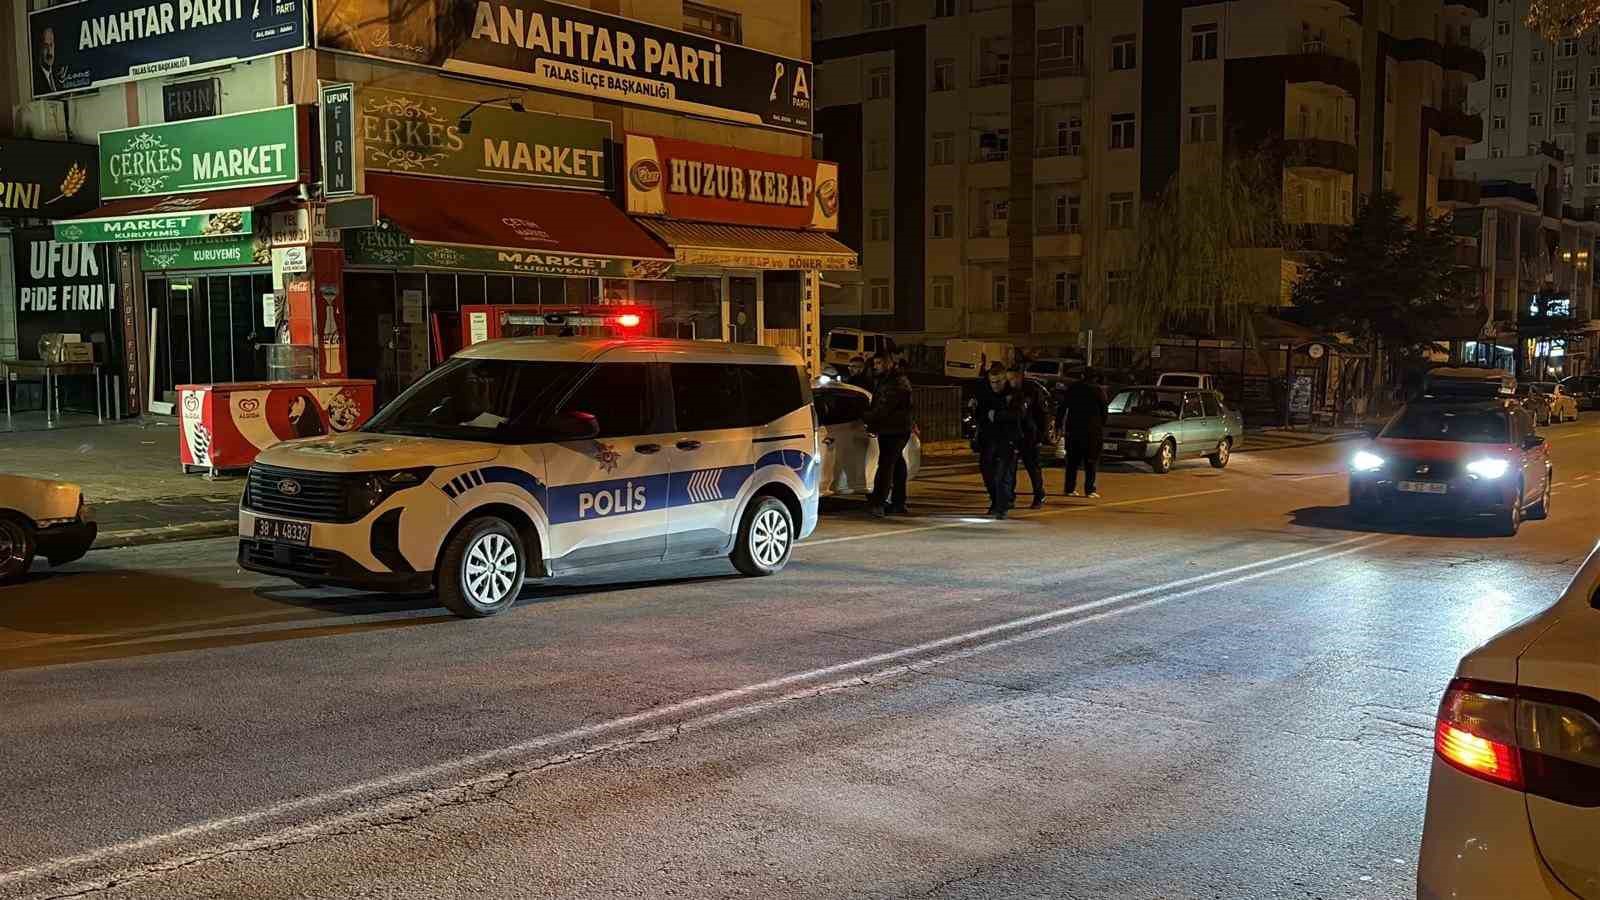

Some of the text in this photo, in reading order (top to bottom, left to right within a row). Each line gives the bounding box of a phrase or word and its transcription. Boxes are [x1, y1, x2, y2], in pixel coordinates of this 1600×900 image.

[79, 3, 174, 50] ANAHTAR
[472, 1, 722, 88] ANAHTAR PARTİ
[326, 92, 349, 104] UFUK
[543, 64, 670, 99] TALAS İLÇE BAŞKANLIĞI
[793, 67, 809, 98] A
[110, 143, 286, 184] ÇERKES MARKET
[334, 105, 344, 188] FIRIN
[363, 115, 463, 151] ERKES
[484, 138, 604, 177] MARKET
[671, 158, 814, 207] HUZUR KEBAP
[104, 216, 192, 233] MARKET
[30, 240, 98, 280] UFUK
[193, 246, 241, 263] KURUYEMİŞ
[498, 251, 612, 269] MARKET
[789, 256, 822, 269] DÖNER
[579, 481, 647, 518] POLİS
[259, 519, 269, 536] 38
[273, 523, 279, 536] A
